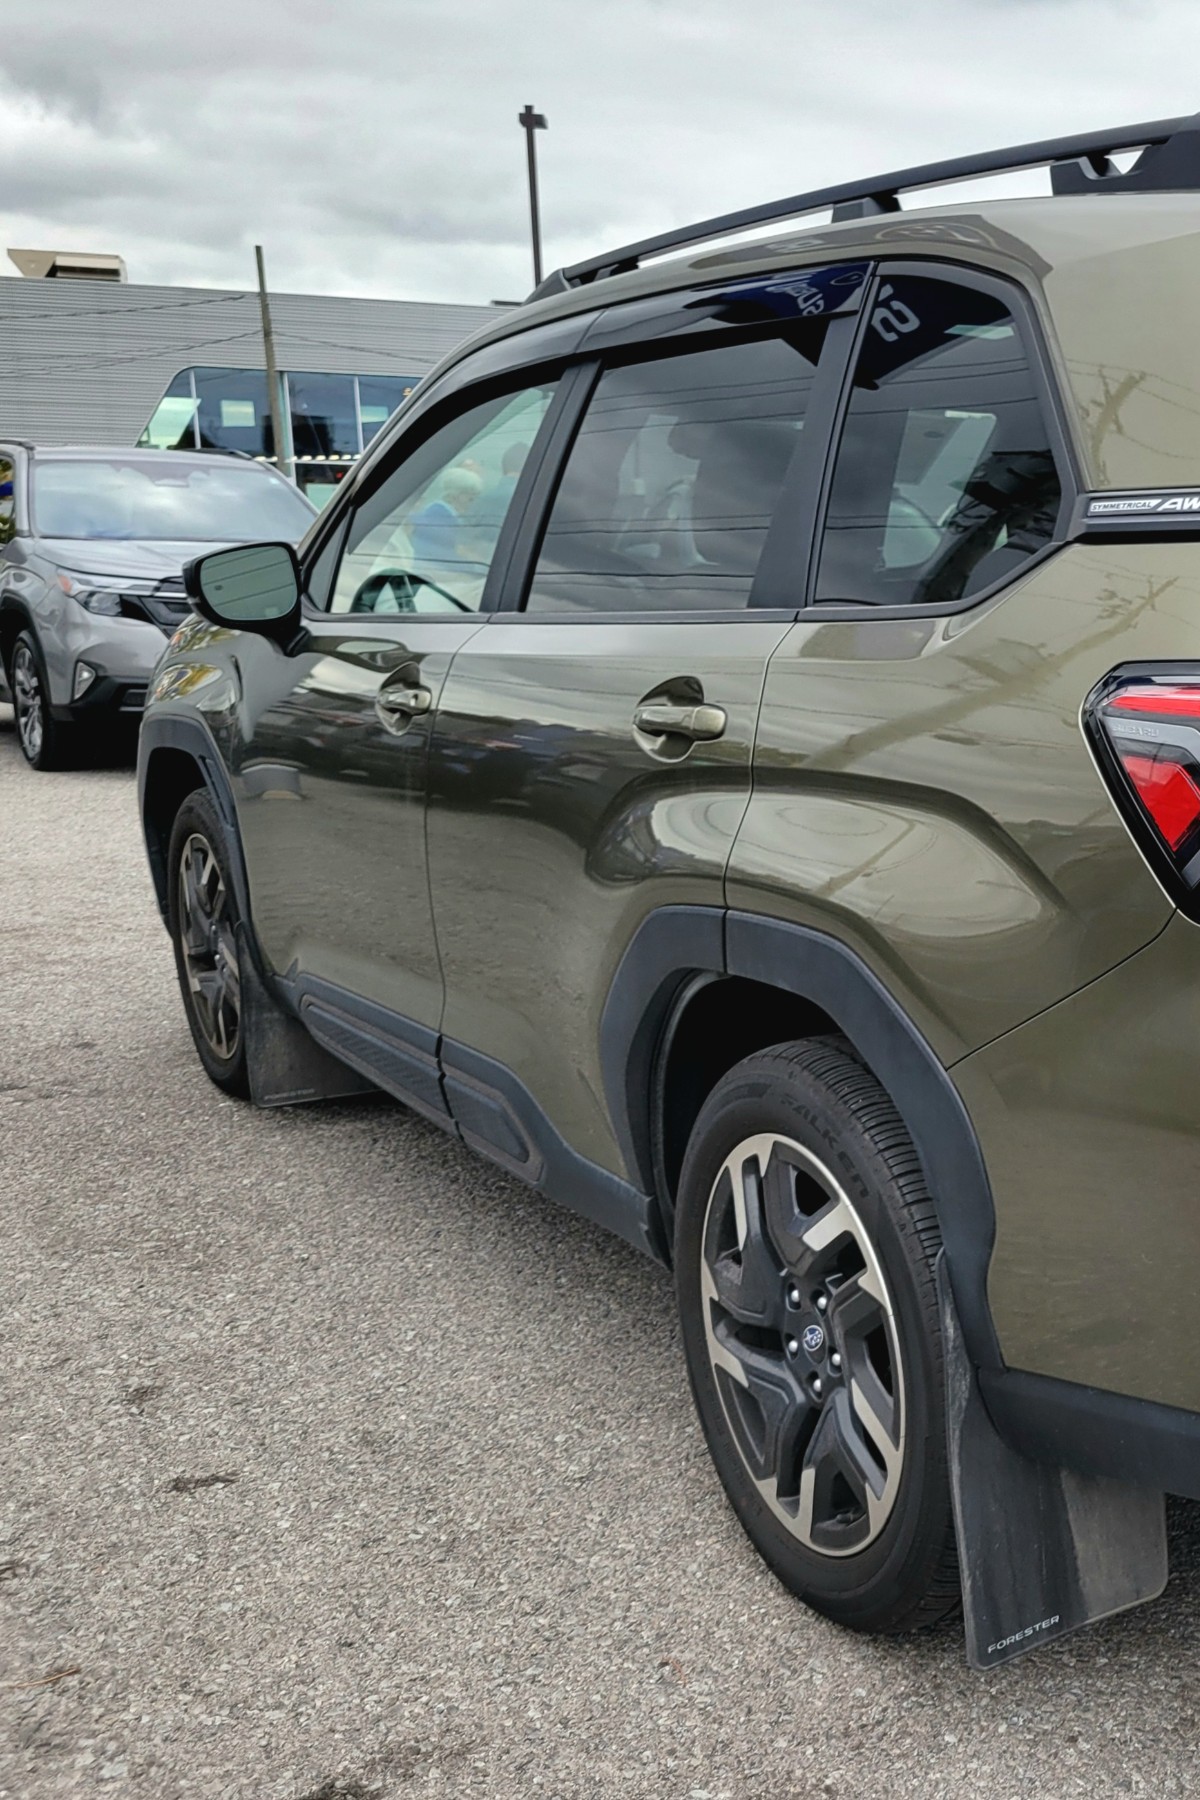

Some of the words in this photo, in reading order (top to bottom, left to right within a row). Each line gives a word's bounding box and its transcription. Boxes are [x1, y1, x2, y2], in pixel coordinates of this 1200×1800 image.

[1091, 501, 1152, 511] SYMMETRICAL
[1112, 724, 1160, 738] SUBARU
[987, 1614, 1060, 1655] FORESTER
